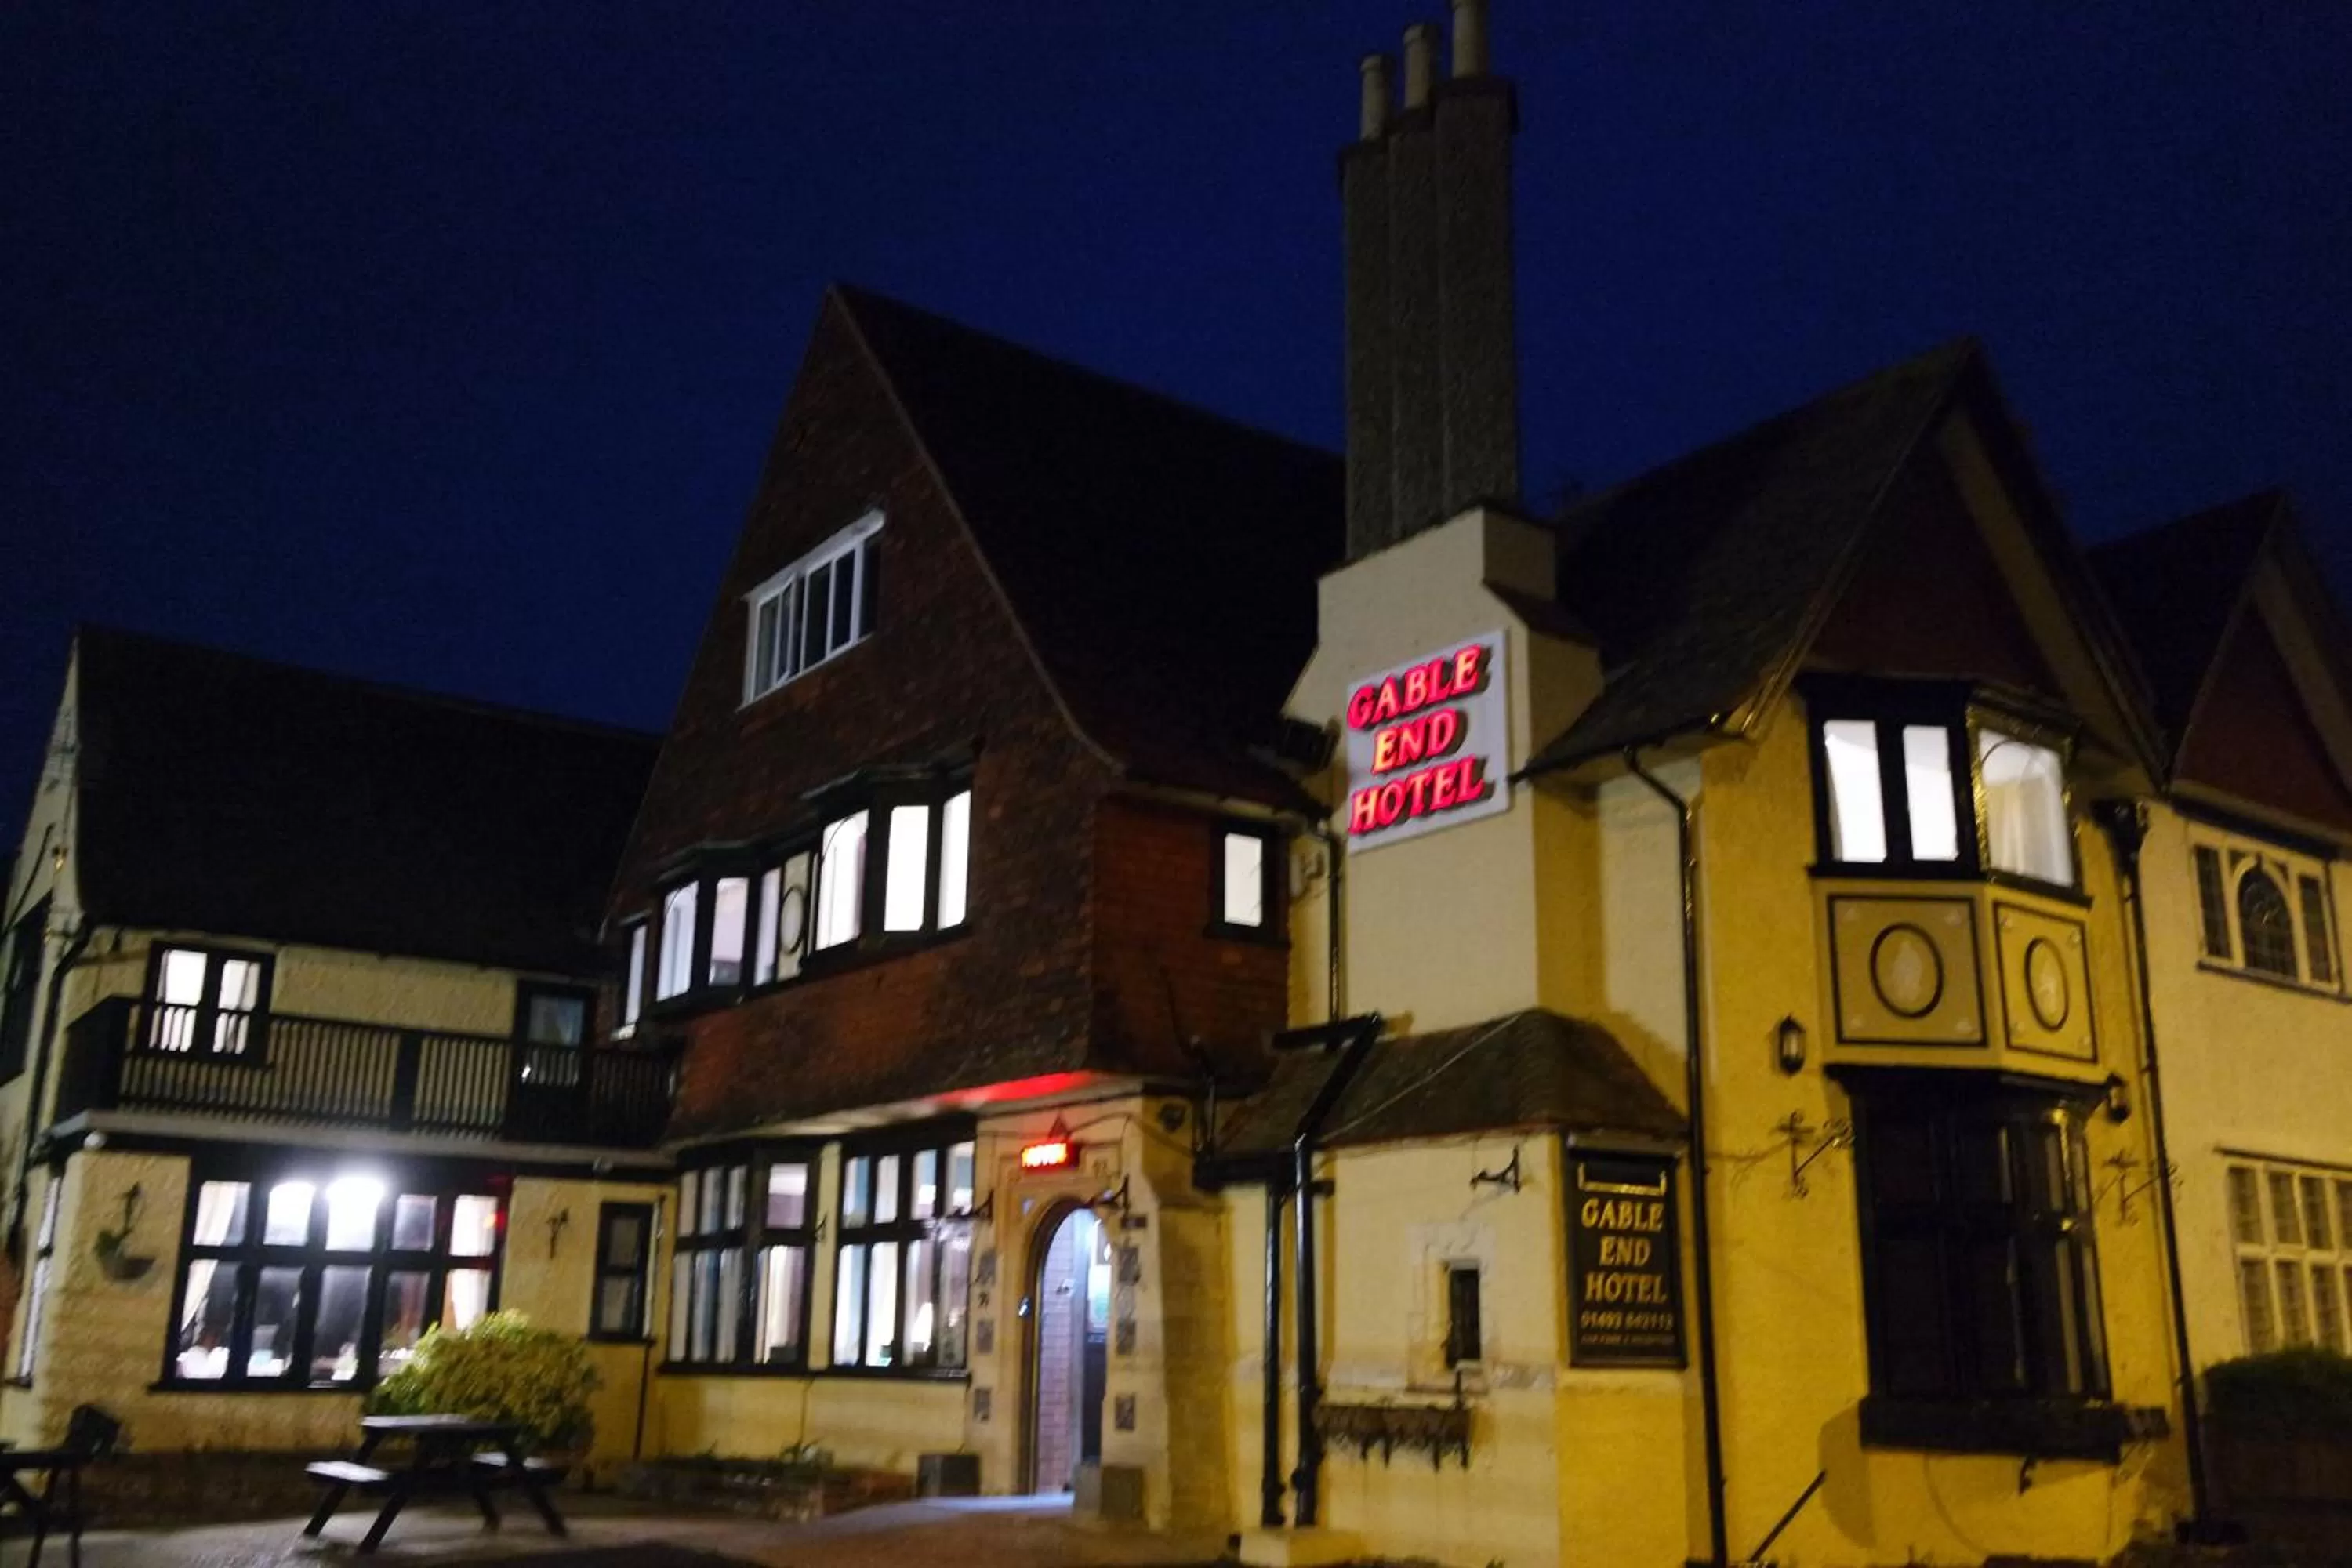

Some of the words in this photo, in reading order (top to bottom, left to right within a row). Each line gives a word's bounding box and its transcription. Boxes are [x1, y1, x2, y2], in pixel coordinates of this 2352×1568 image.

[1347, 643, 1481, 731] GABLE
[1372, 708, 1457, 775] END
[1348, 755, 1485, 837] HOTEL
[1581, 1197, 1664, 1232] GABLE
[1599, 1236, 1652, 1266] END
[1584, 1271, 1667, 1304] HOTEL
